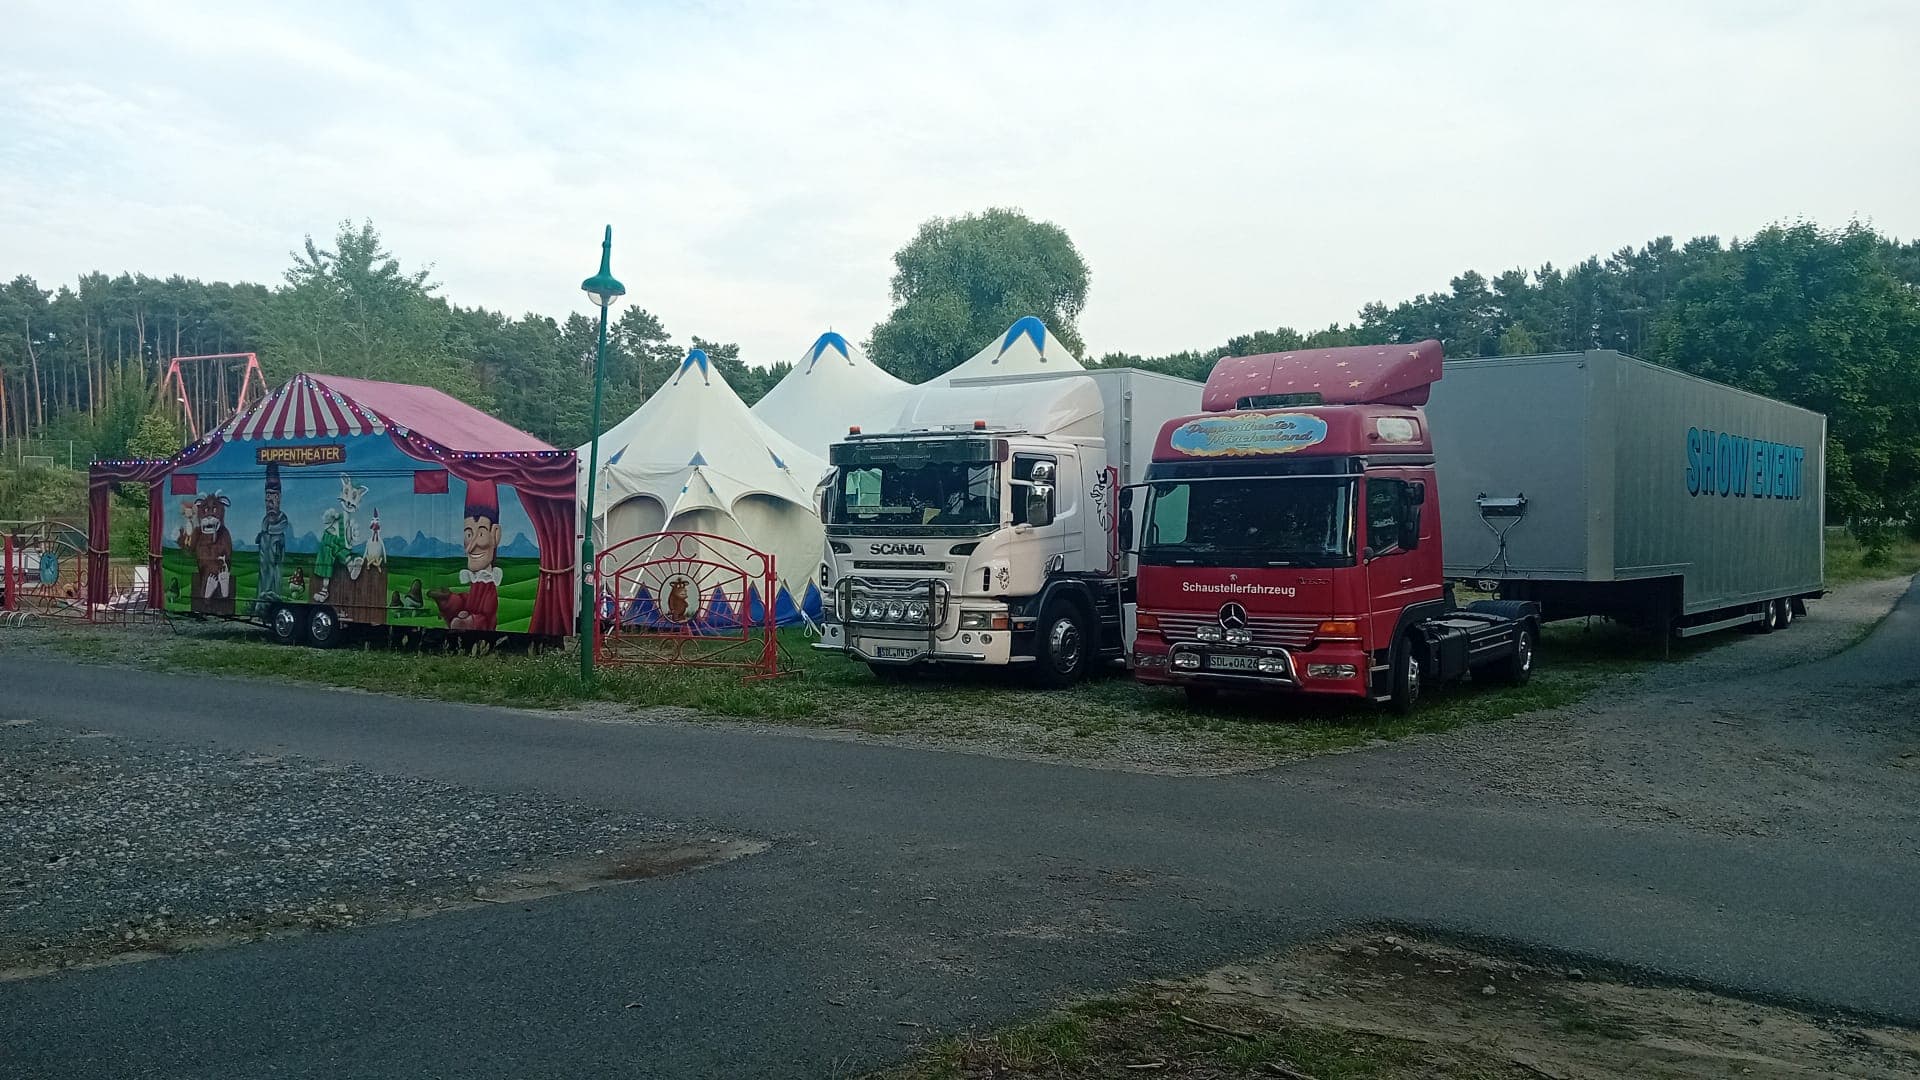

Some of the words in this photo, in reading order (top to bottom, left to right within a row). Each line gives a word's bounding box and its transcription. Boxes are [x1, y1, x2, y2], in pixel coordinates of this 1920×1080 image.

[261, 447, 339, 462] PUPPENTHEATER
[1686, 426, 1749, 498] SHOW
[1752, 439, 1804, 500] EVENT
[870, 543, 926, 556] SCANIA
[1182, 582, 1296, 597] Schaustellerfahrzeug
[1211, 656, 1228, 667] SDL
[1234, 658, 1246, 669] OA
